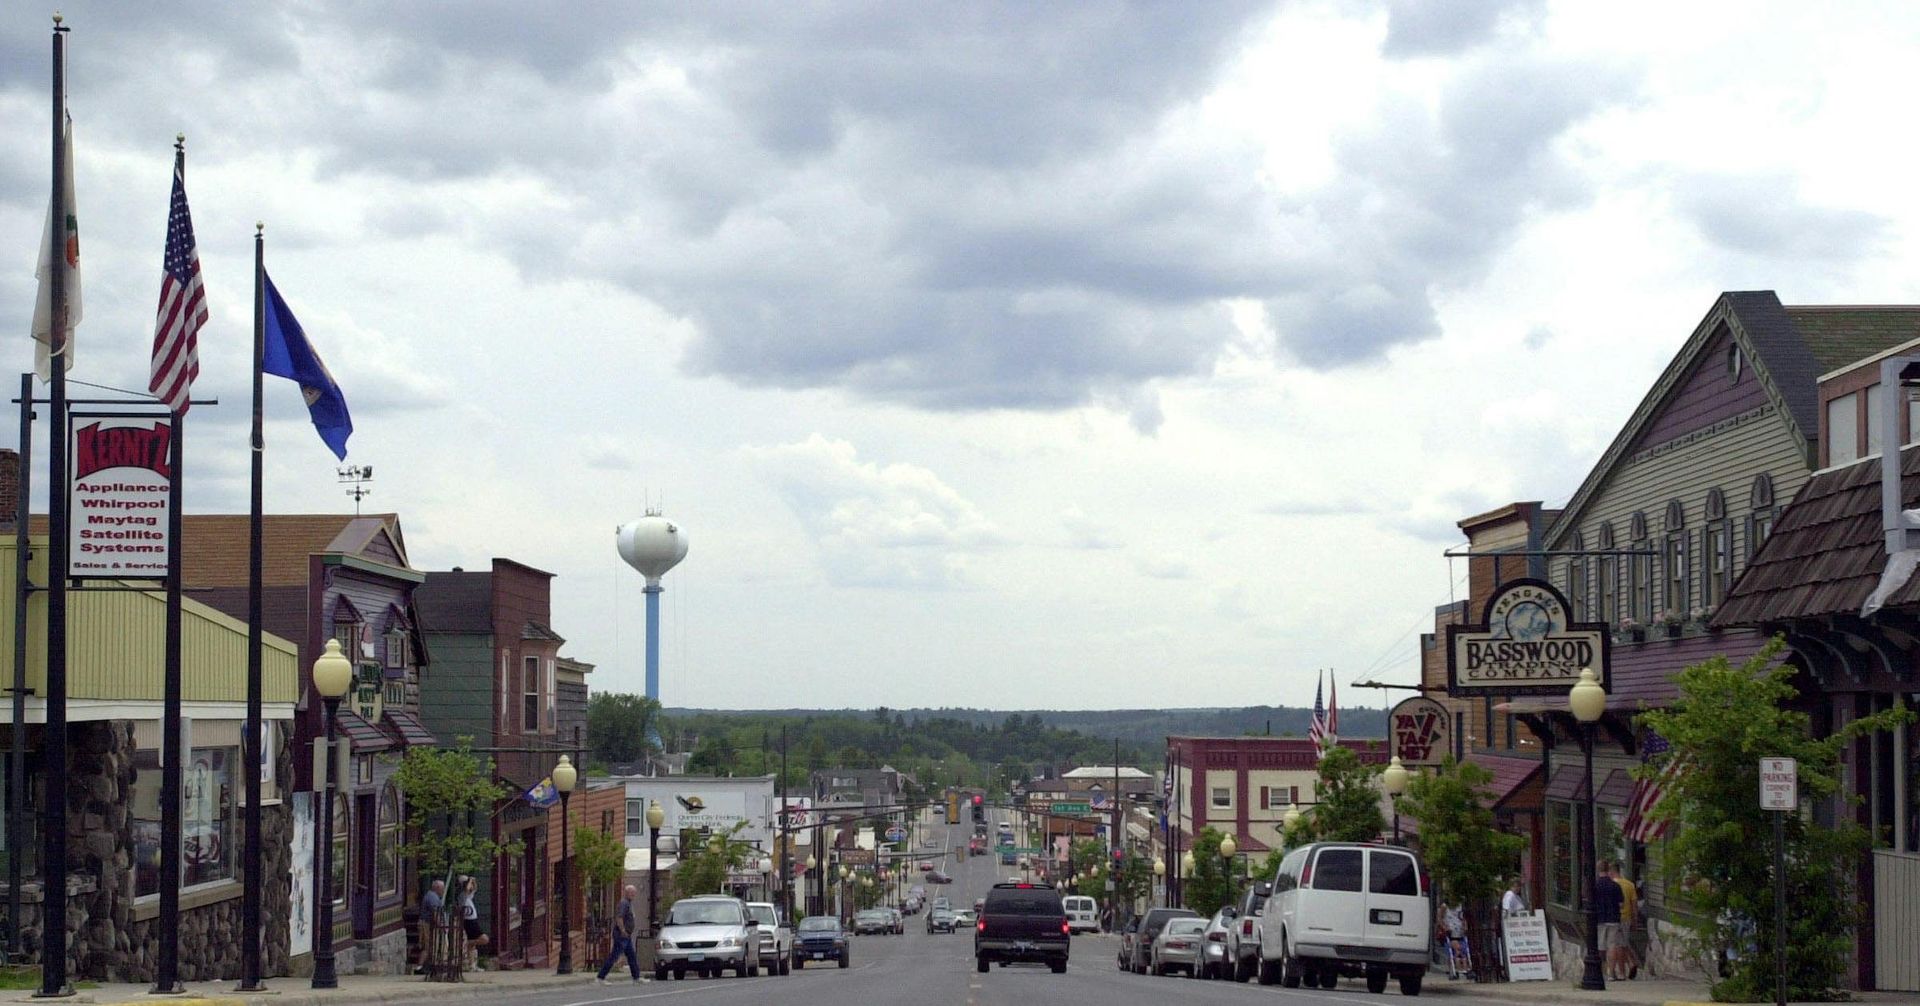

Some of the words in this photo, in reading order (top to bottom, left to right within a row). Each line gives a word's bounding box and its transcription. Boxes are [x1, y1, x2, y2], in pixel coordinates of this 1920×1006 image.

[75, 421, 170, 480] KERNTZ
[76, 483, 169, 493] Appliance
[81, 500, 165, 510] Whirpool
[88, 515, 157, 526] Maytag
[80, 529, 164, 539] Satellite
[80, 543, 165, 554] Systems
[1466, 640, 1593, 670] BASSWOOD
[1485, 661, 1575, 669] TRADING
[1468, 668, 1582, 678] COMPAN
[1397, 746, 1432, 761] HEY
[1772, 761, 1783, 771] NO
[1763, 773, 1793, 783] PARKING
